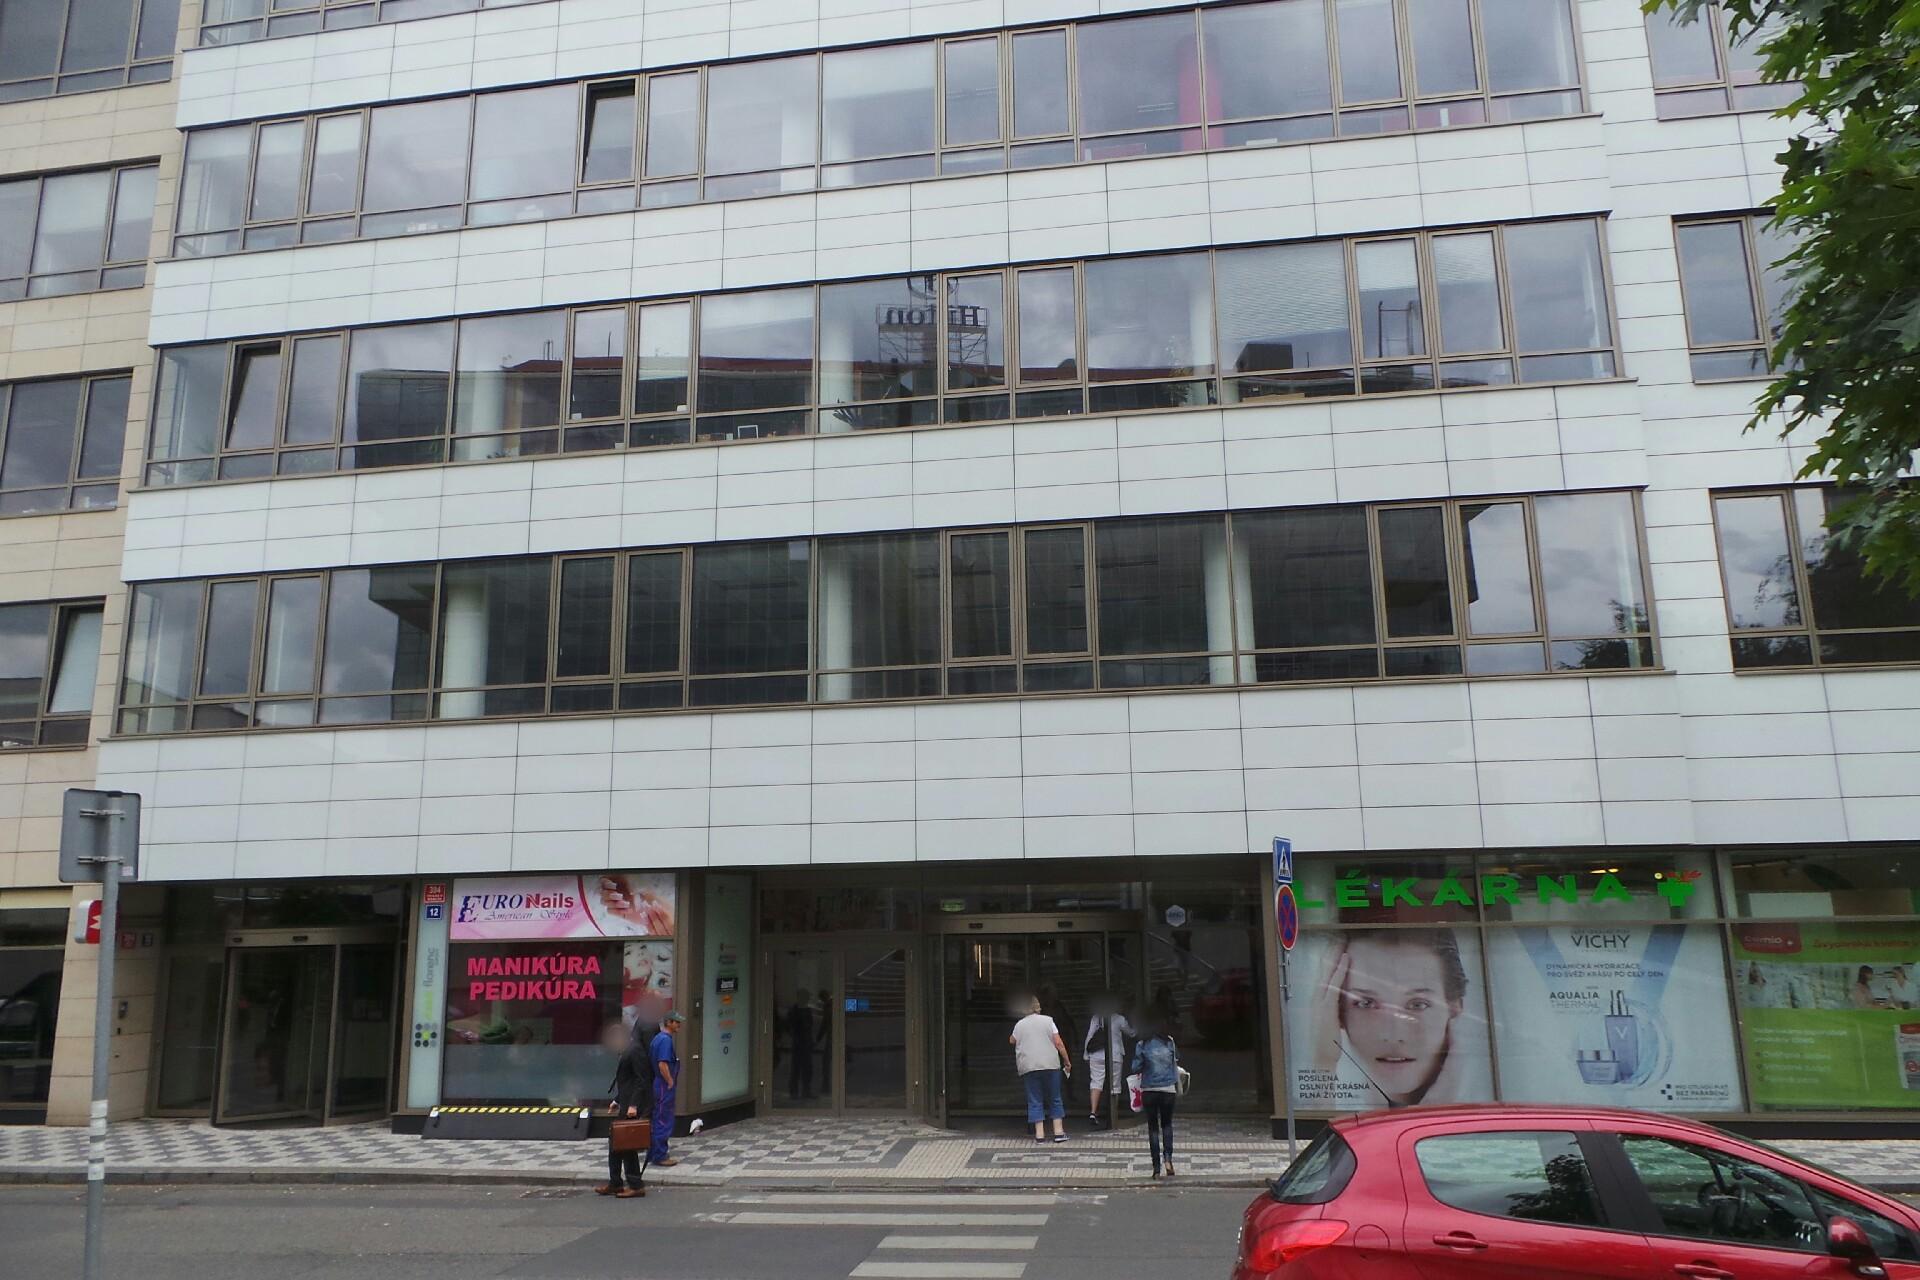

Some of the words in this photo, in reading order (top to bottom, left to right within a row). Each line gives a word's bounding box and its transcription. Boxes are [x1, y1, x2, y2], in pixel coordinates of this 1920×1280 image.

[1293, 869, 1634, 908] LÉKÁRNA
[525, 893, 574, 909] Nails
[429, 907, 439, 917] 12
[1570, 934, 1631, 949] VICHY
[467, 952, 601, 976] MANIKÚRA
[469, 976, 597, 1001] PEDIKÚRA
[1549, 991, 1600, 1000] AQUALIA
